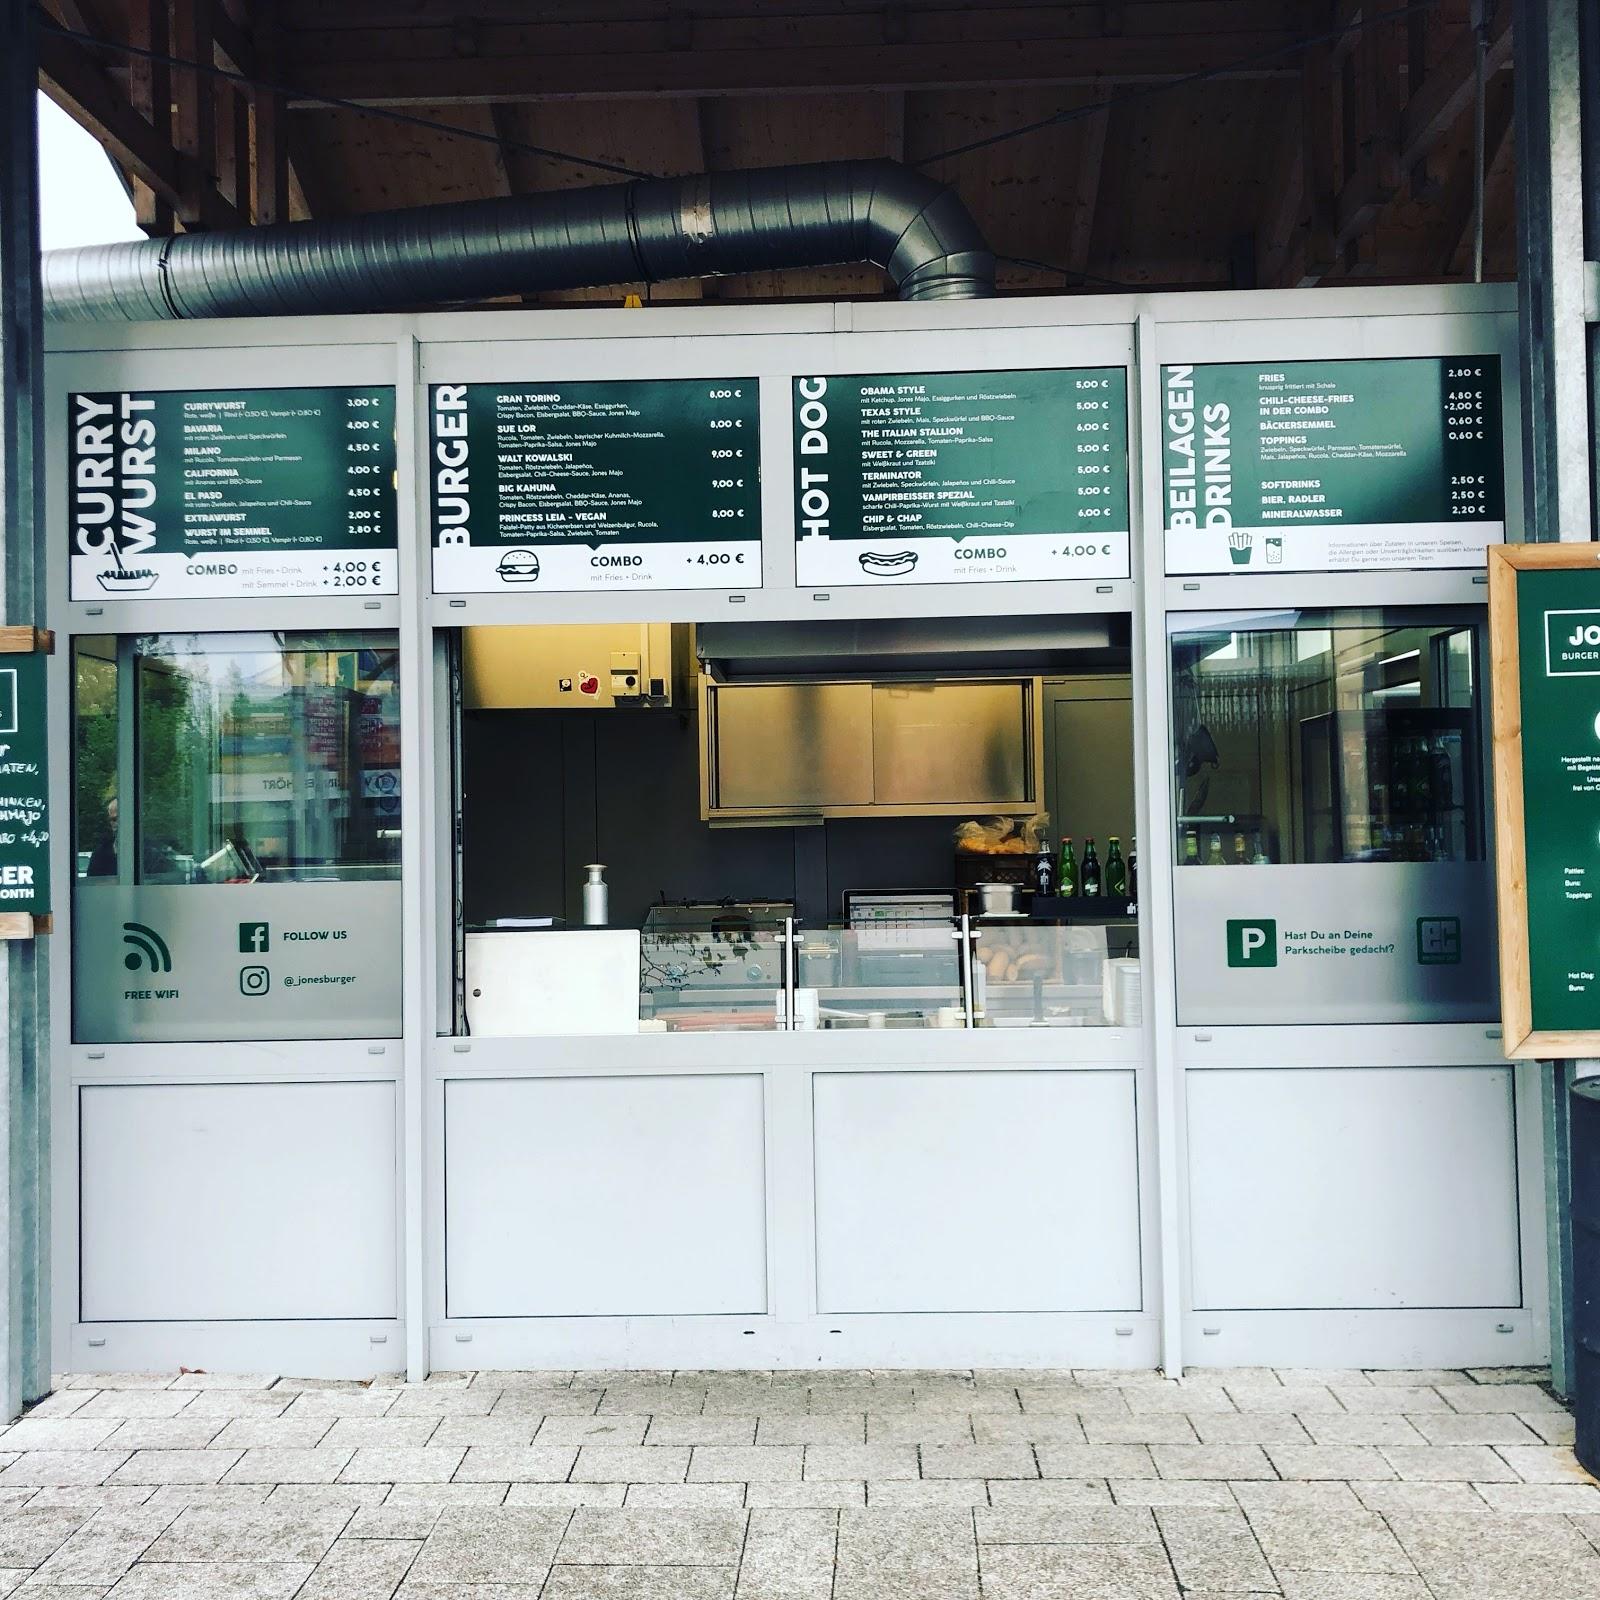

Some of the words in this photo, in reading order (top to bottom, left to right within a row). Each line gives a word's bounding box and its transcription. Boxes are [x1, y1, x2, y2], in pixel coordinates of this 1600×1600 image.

[1259, 374, 1285, 382] FRIES
[1449, 369, 1471, 377] 2,80
[861, 387, 895, 395] OBAMA
[898, 386, 925, 394] STYLE
[1076, 381, 1098, 389] 5,00
[497, 395, 522, 403] GRAN
[710, 390, 731, 398] 8,00
[1260, 395, 1354, 404] CHILI-CHEESE-FRIES
[1449, 392, 1472, 400] 4,80
[184, 402, 247, 410] CURRYWURST
[372, 398, 379, 406] €
[800, 378, 827, 454] DOG
[861, 408, 890, 416] TEXAS
[1273, 407, 1291, 415] DER
[1294, 406, 1328, 414] COMBO
[184, 425, 223, 433] BAVARIA
[347, 421, 369, 429] 4,00
[497, 425, 515, 433] SUE
[711, 420, 732, 428] 8,00
[1260, 421, 1336, 429] BÄCKERSEMMEL
[1448, 417, 1472, 425] 0,60
[882, 429, 917, 437] ITALIAN
[920, 428, 963, 436] STALLION
[1077, 423, 1099, 431] 6,00
[1260, 436, 1307, 444] TOPPINGS
[184, 447, 221, 455] MILANO
[348, 444, 370, 452] 4,50
[372, 443, 379, 451] €
[1168, 366, 1197, 529] BEILAGEN
[525, 454, 572, 462] KOWALSKI
[712, 450, 733, 458] 9,00
[436, 386, 470, 547] BURGER
[1203, 403, 1232, 528] DRINKS
[77, 395, 115, 555] CURRY
[121, 394, 157, 555] WURST
[184, 469, 239, 477] CALIFORNIA
[862, 471, 921, 480] TERMINATOR
[517, 484, 556, 492] KAHUNA
[712, 480, 733, 488] 9,00
[1261, 480, 1320, 489] SOFTDRINKS
[863, 492, 935, 501] VAMPIRBEISSER
[937, 491, 975, 500] SPEZIAL
[1262, 496, 1285, 504] BIER,
[1289, 495, 1325, 503] RADLER
[801, 468, 830, 541] HOT
[185, 514, 246, 522] EXTRAWURST
[500, 514, 543, 522] PRINCESS
[712, 510, 734, 518] 8,00
[737, 509, 744, 517] €
[1262, 509, 1342, 518] MINERALWASSER
[1453, 506, 1475, 514] 2,20
[863, 515, 884, 523] CHIP
[897, 514, 922, 522] CHAP
[219, 528, 231, 536] IM
[349, 526, 371, 534] 2,80
[374, 525, 380, 533] €
[954, 548, 1006, 559] COMBO
[1063, 545, 1096, 556] 4,00
[1102, 545, 1110, 555] €
[591, 556, 642, 566] COMBO
[697, 554, 730, 564] 4,00
[736, 553, 744, 563] €
[186, 564, 237, 575] COMBO
[334, 562, 366, 572] 4,00
[372, 562, 380, 571] €
[334, 576, 366, 586] 2,00
[372, 576, 380, 585] €
[1562, 652, 1598, 660] BURGER
[1561, 756, 1591, 764] Hergestellt
[0, 866, 33, 885] ER
[0, 889, 34, 899] ONTH
[284, 932, 329, 940] FOLLOW
[333, 931, 347, 939] US
[1242, 928, 1265, 958] P
[1311, 931, 1324, 939] Du
[1344, 931, 1372, 939] Deine
[1286, 946, 1346, 954] Parkscheibe
[1350, 944, 1395, 956] gedacht?
[284, 976, 356, 986] @_jonesburger
[125, 991, 151, 999] FREE
[155, 990, 178, 998] WIFI
